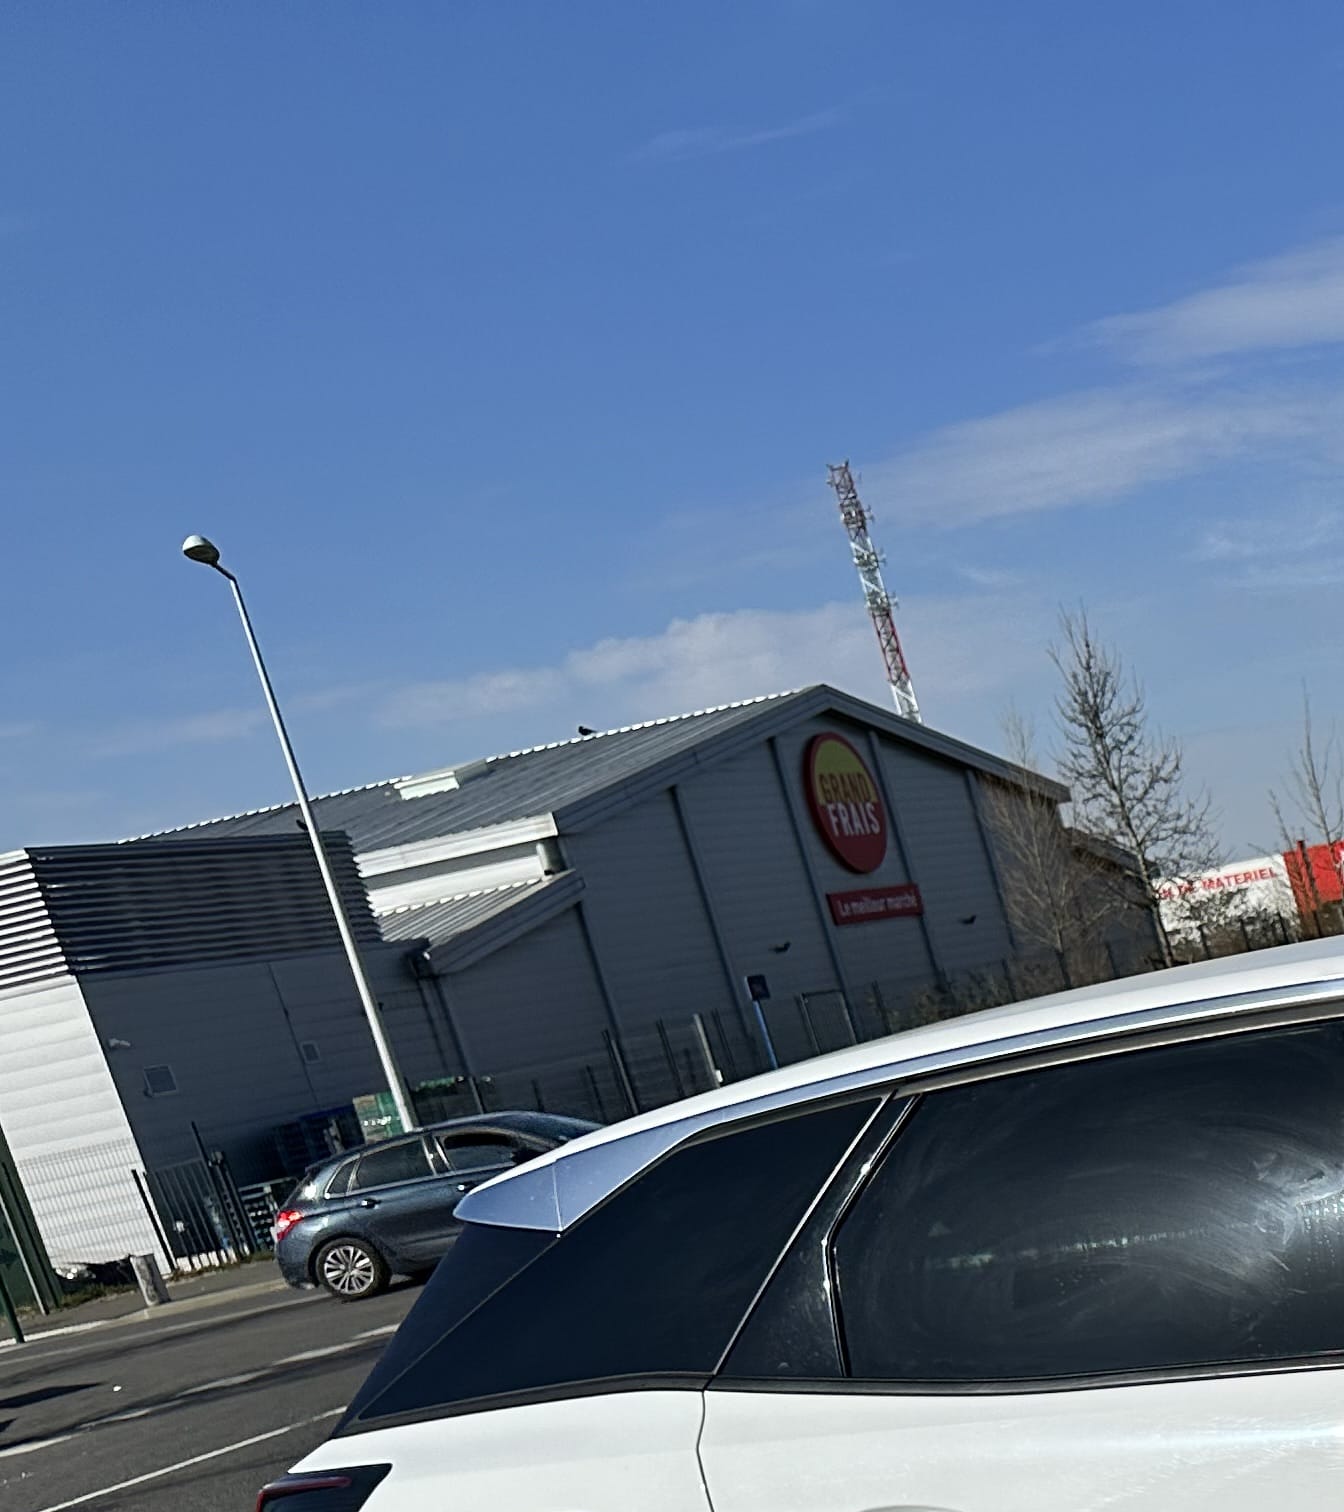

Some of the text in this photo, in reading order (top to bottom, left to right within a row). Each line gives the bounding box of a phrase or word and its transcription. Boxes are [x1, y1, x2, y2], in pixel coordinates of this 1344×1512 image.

[818, 772, 872, 803] GRAND
[827, 802, 881, 836] FRAIS
[1200, 866, 1278, 892] MATERIEL
